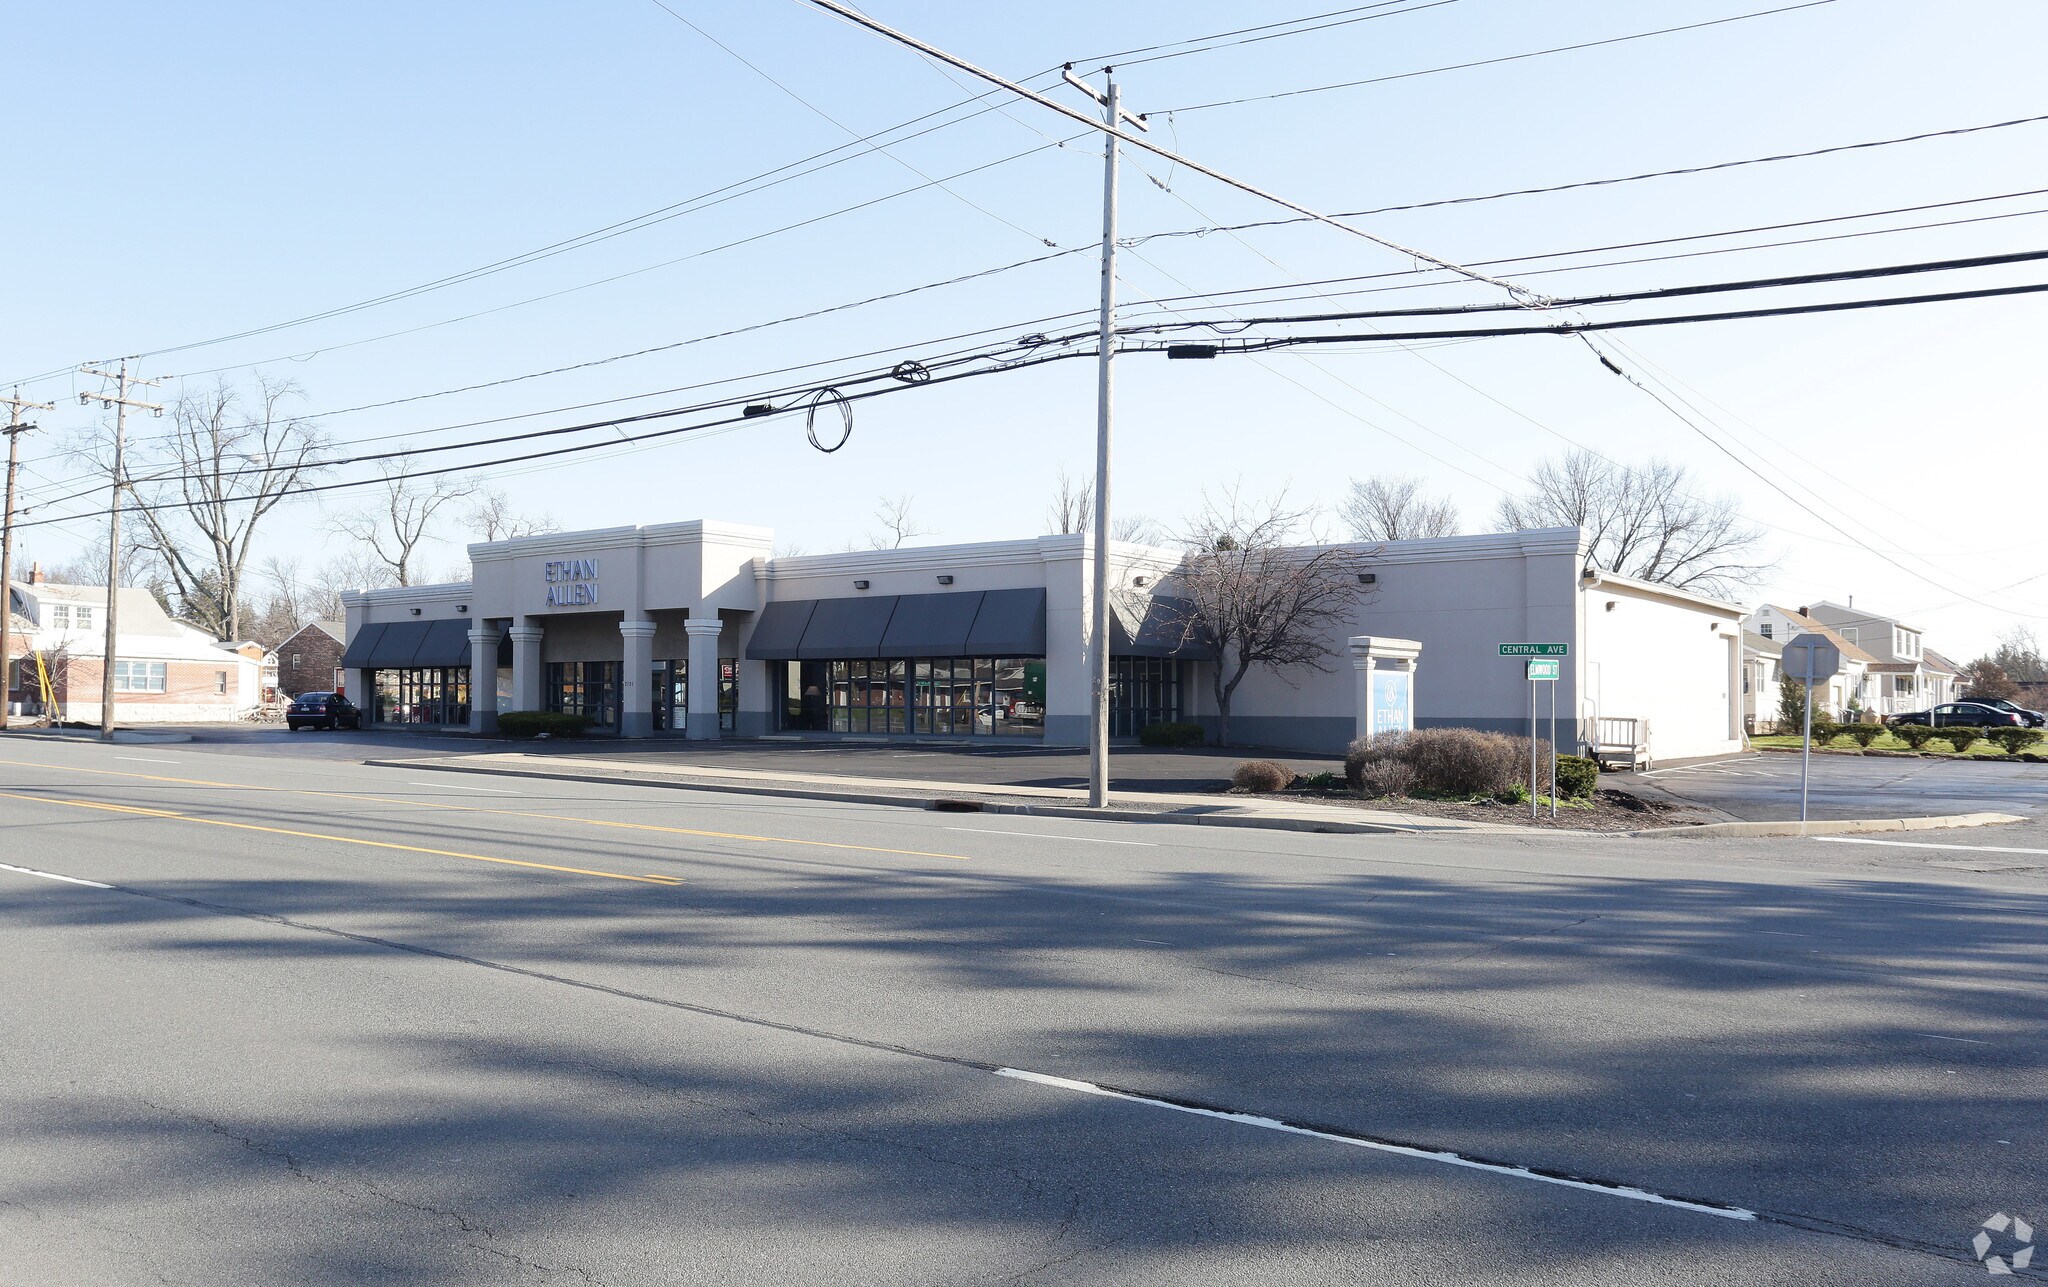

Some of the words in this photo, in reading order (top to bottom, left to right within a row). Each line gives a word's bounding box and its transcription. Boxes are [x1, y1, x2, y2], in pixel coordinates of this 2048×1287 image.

[545, 559, 597, 582] ETHAN
[545, 584, 597, 606] ALLEN
[1502, 645, 1541, 654] CENTRAL
[1547, 645, 1564, 654] AVE
[1378, 709, 1404, 723] ETHAN
